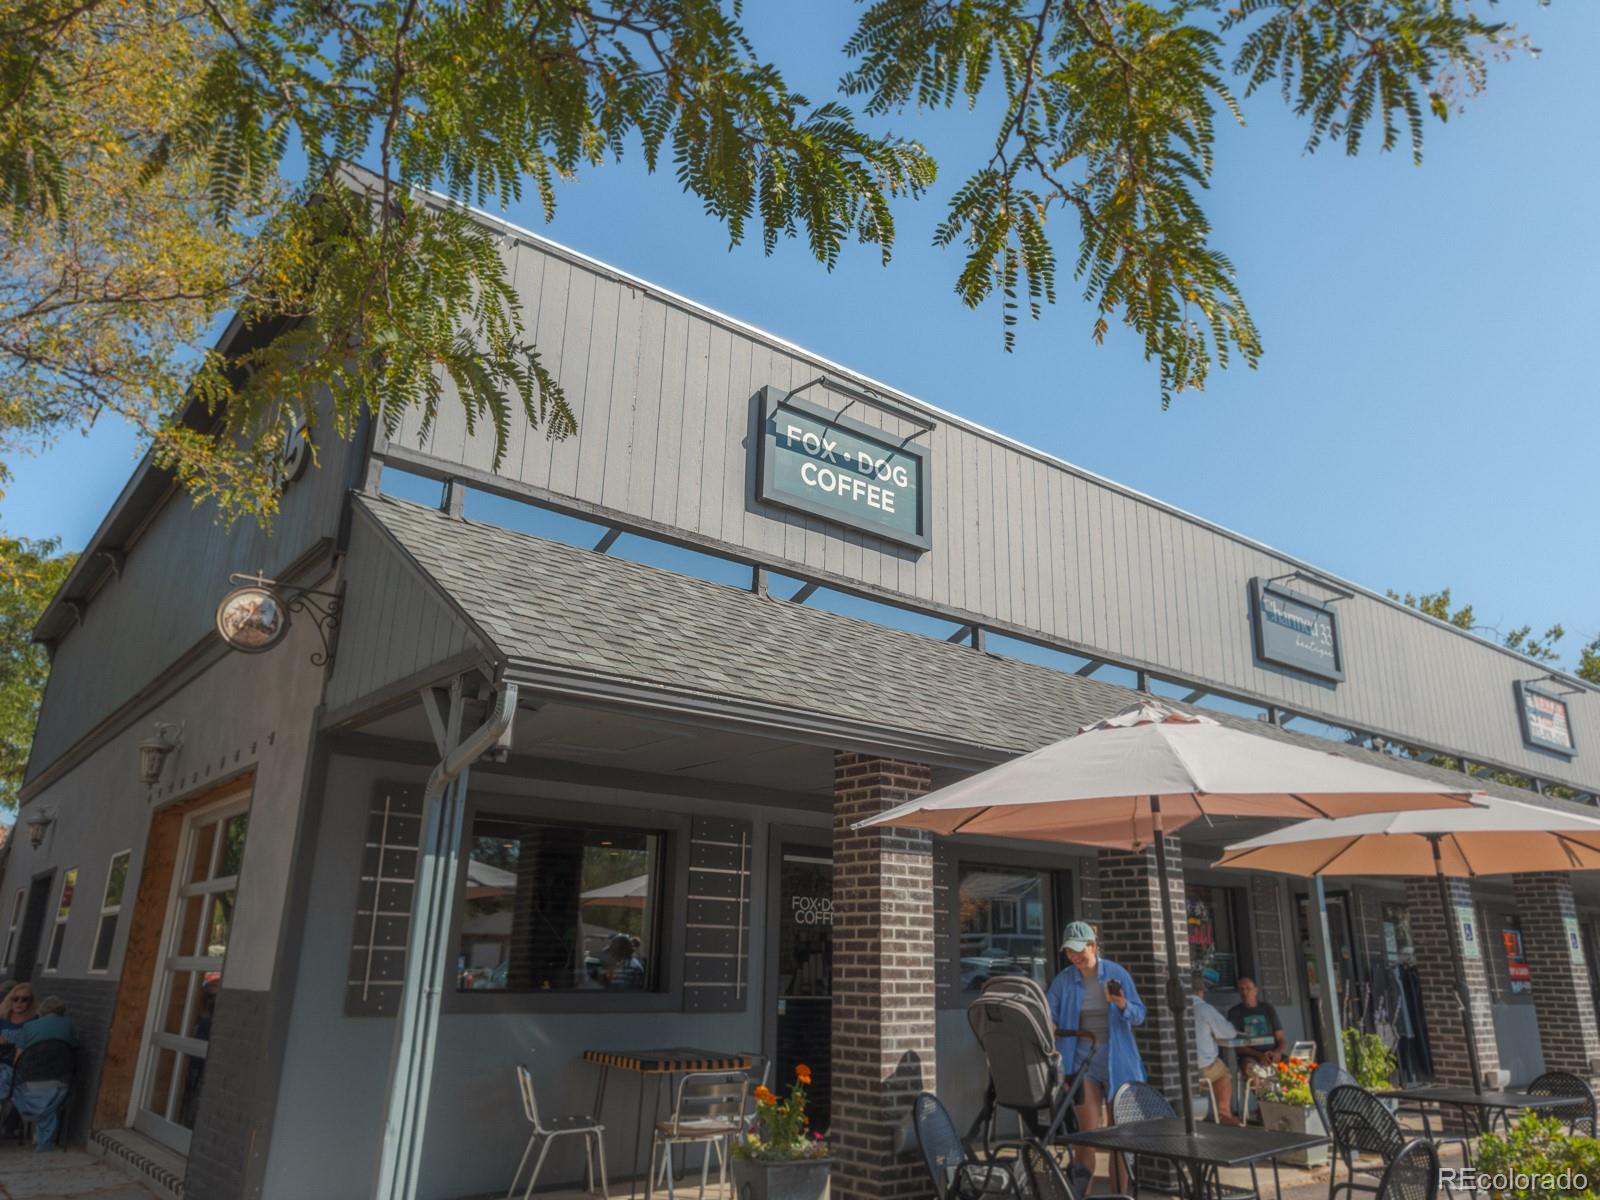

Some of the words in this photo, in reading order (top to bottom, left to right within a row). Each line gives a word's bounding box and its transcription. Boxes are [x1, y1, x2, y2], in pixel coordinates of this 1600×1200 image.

[786, 425, 837, 463] FOX
[857, 451, 908, 487] DOG
[800, 462, 895, 513] COFFEE
